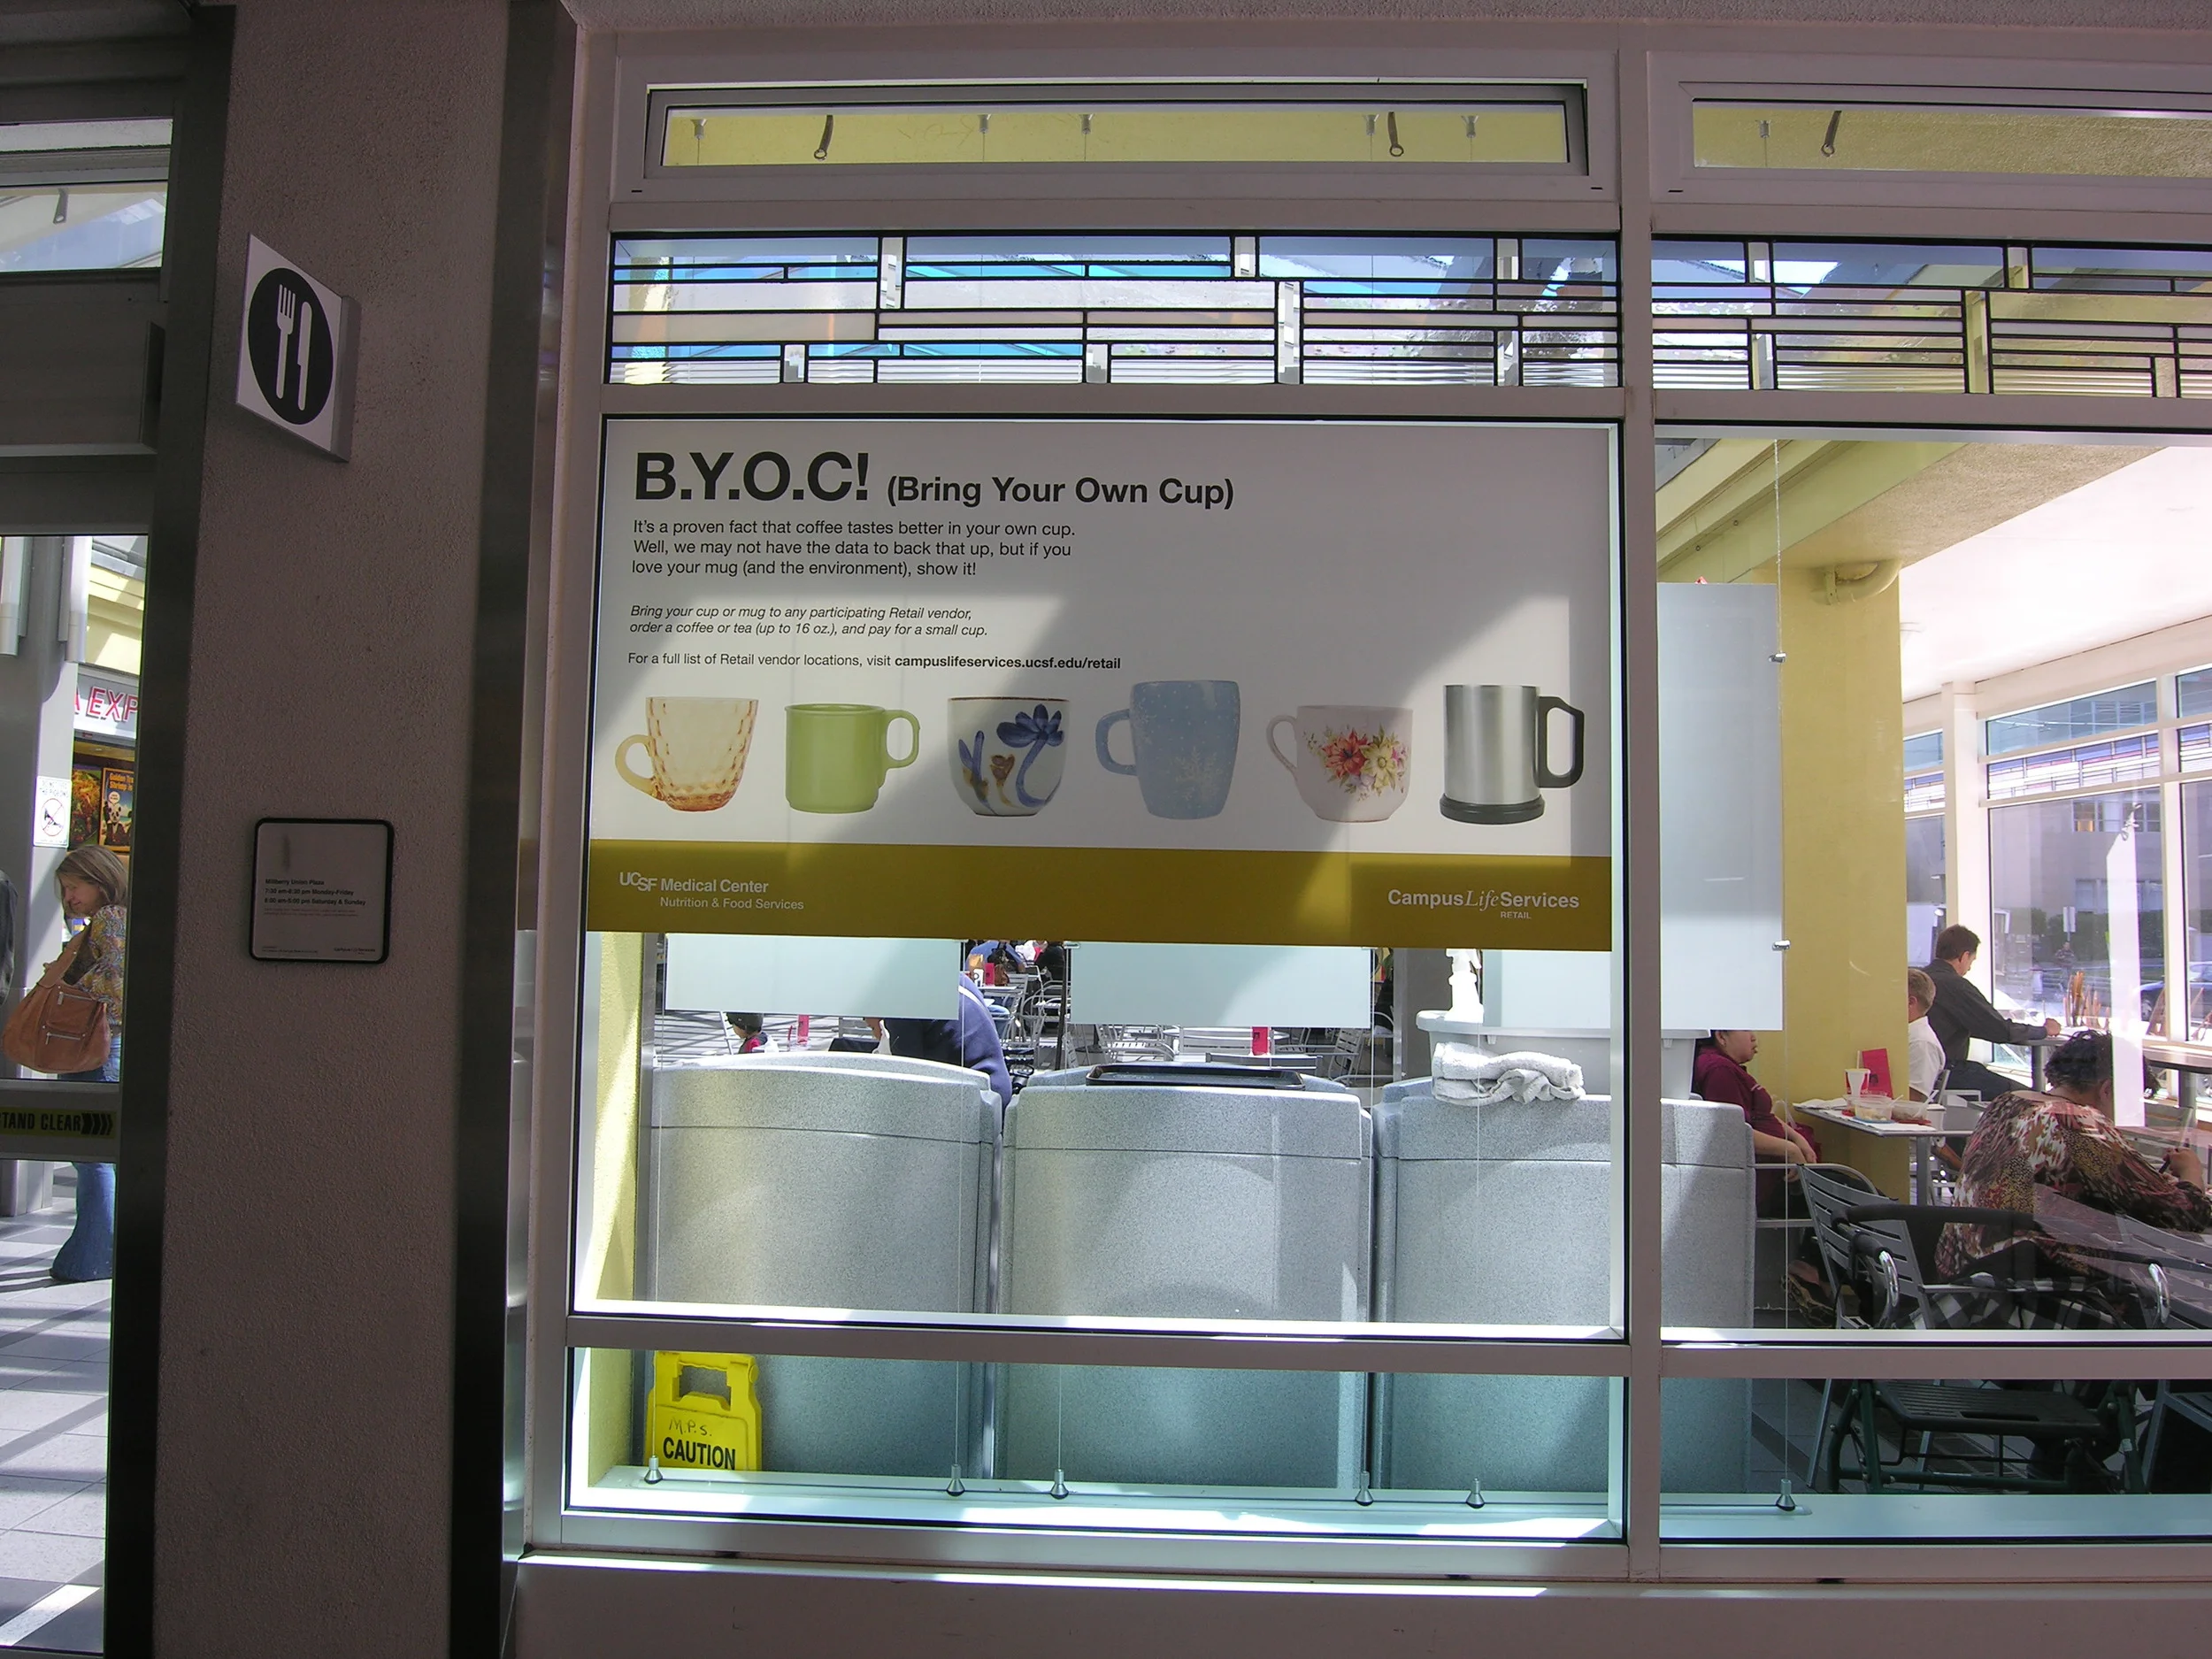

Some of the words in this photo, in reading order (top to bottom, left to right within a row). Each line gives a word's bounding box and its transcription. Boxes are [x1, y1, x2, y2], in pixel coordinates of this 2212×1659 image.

[635, 451, 869, 502] B.Y.O.C!
[887, 475, 981, 509] (Bring
[991, 476, 1066, 503] Your
[1075, 476, 1148, 503] Own
[1158, 477, 1234, 511] Cup)
[658, 523, 669, 534] a
[672, 523, 725, 537] proven
[728, 520, 758, 534] fact
[761, 520, 792, 534] that
[795, 520, 845, 534] coffee
[847, 521, 894, 534] tastes
[898, 521, 945, 534] better
[948, 521, 962, 535] in
[965, 525, 1001, 539] your
[1004, 526, 1037, 535] own
[1041, 526, 1076, 539] cup.
[632, 540, 669, 557] Well,
[673, 543, 696, 554] we
[700, 543, 733, 558] may
[736, 541, 762, 555] not
[765, 541, 803, 555] have
[805, 541, 831, 555] the
[834, 541, 870, 555] data
[872, 542, 889, 556] to
[894, 541, 932, 556] back
[934, 541, 966, 556] that
[970, 545, 995, 559] up,
[999, 542, 1025, 557] but
[1029, 542, 1040, 557] if
[1042, 545, 1071, 560] you
[632, 560, 663, 574] love
[666, 564, 702, 578] your
[704, 564, 738, 578] mug
[742, 560, 776, 578] (and
[780, 561, 805, 575] the
[809, 561, 912, 579] environment),
[916, 562, 959, 576] show
[963, 562, 976, 576] it!
[629, 605, 664, 621] Bring
[664, 608, 695, 621] your
[695, 609, 719, 621] cup
[721, 609, 737, 618] or
[737, 609, 765, 621] mug
[768, 607, 782, 618] to
[783, 609, 808, 622] any
[808, 606, 887, 622] participating
[888, 607, 926, 619] Retail
[926, 607, 972, 623] vendor,
[629, 622, 664, 634] order
[664, 625, 673, 634] a
[675, 622, 715, 634] coffee
[717, 625, 732, 634] or
[733, 622, 753, 634] tea
[755, 622, 776, 637] (up
[778, 624, 791, 634] to
[795, 623, 811, 634] 16
[812, 623, 838, 638] oz.),
[841, 623, 867, 635] and
[867, 626, 892, 638] pay
[894, 623, 913, 635] for
[914, 626, 923, 635] a
[925, 624, 959, 635] small
[961, 626, 987, 639] cup.
[627, 652, 649, 664] For
[650, 656, 659, 664] a
[662, 652, 680, 664] full
[683, 652, 702, 664] list
[703, 653, 718, 665] of
[719, 653, 755, 665] Retail
[757, 653, 802, 665] vendor
[803, 653, 863, 669] locations,
[866, 654, 892, 666] visit
[894, 655, 1121, 670] campuslifeservices.ucsf.edu/retail
[619, 872, 658, 892] UCSF
[660, 879, 717, 892] Medical
[719, 879, 769, 894] Center
[660, 896, 709, 908] Nutrition
[710, 897, 720, 909] &
[723, 897, 753, 909] Food
[755, 898, 804, 910] Services
[1500, 910, 1532, 920] RETAIL
[0, 1111, 35, 1130] TAND
[41, 1113, 81, 1132] CLEAR
[663, 1437, 736, 1471] CAUTION
